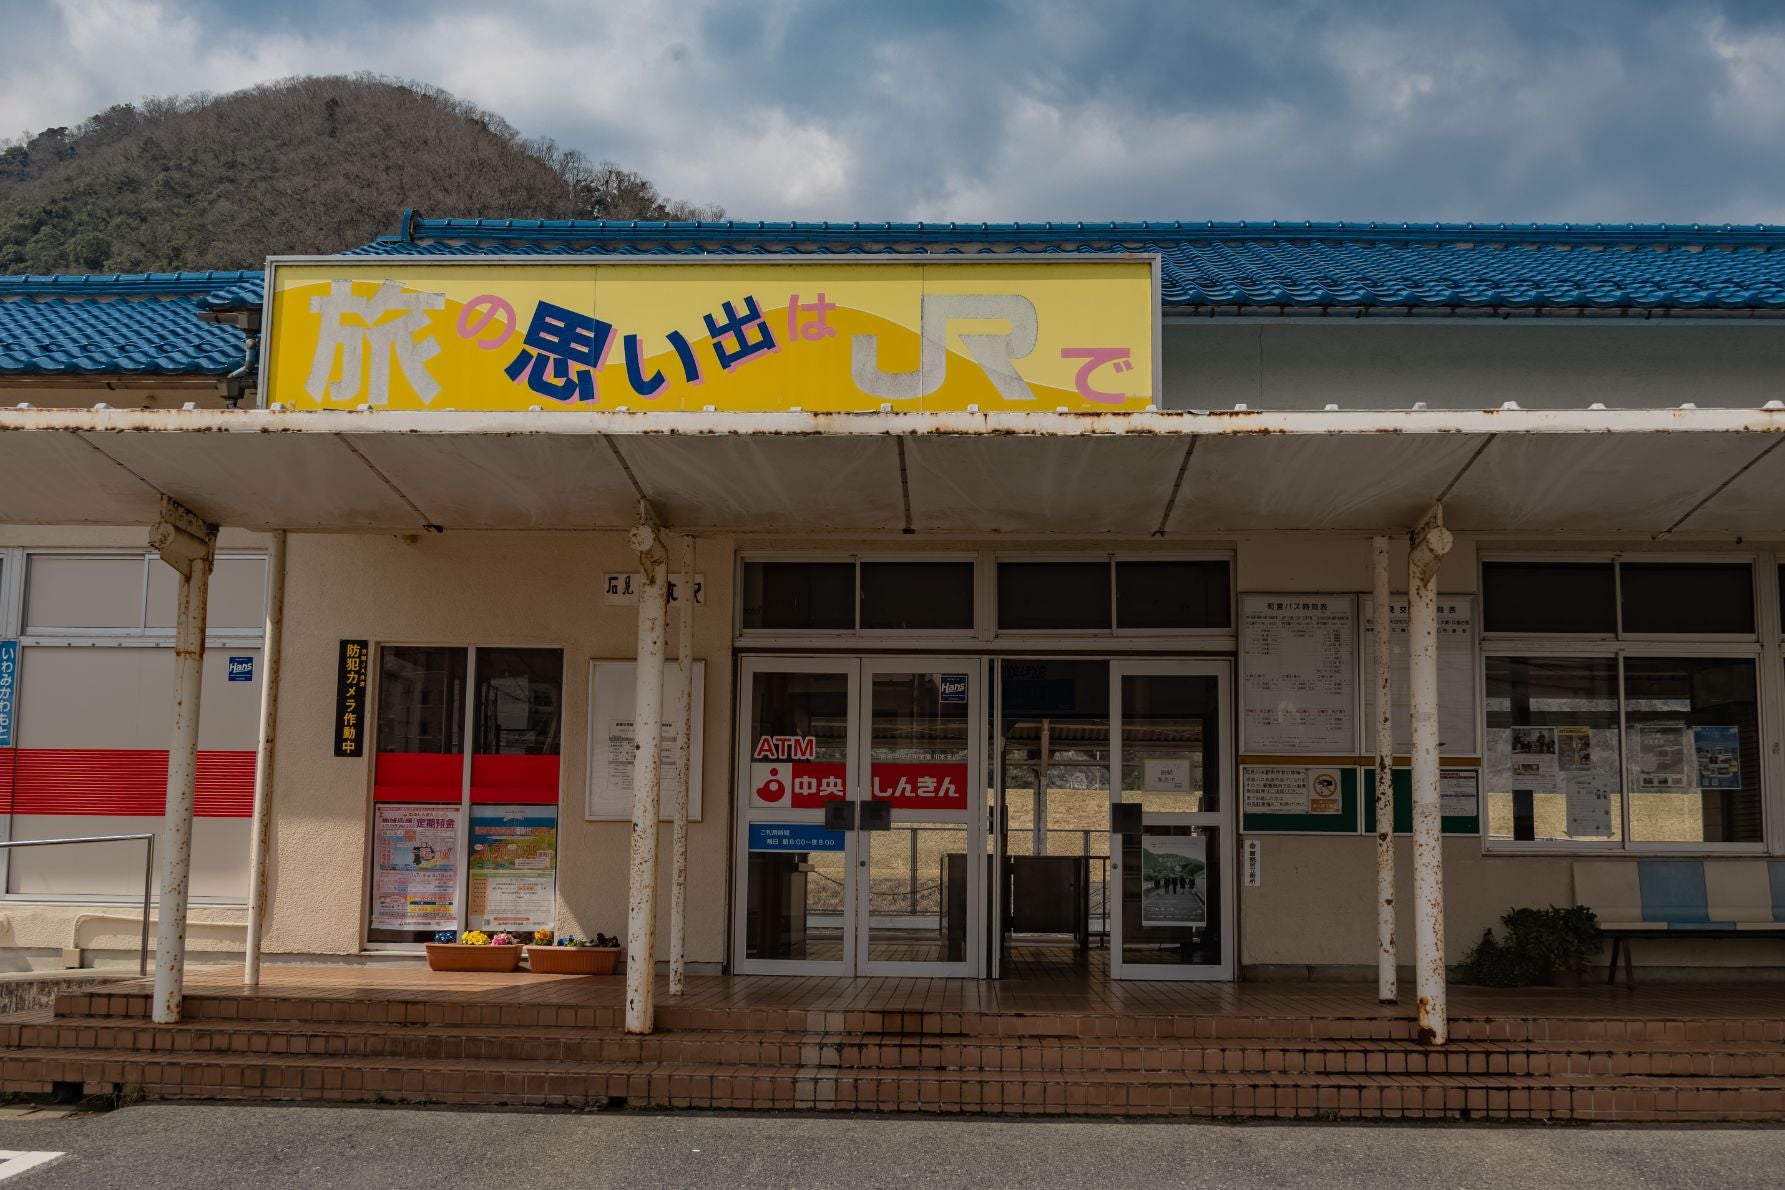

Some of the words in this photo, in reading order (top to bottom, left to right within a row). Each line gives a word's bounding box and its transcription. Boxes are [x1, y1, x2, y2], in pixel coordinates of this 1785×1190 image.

[305, 279, 1134, 406] 旅の思い出はJRで
[229, 662, 253, 674] Hans
[941, 682, 965, 694] Hans
[342, 643, 361, 754] 防犯カメラ作動中
[755, 736, 815, 759] ATM
[416, 818, 456, 829] 定期預金
